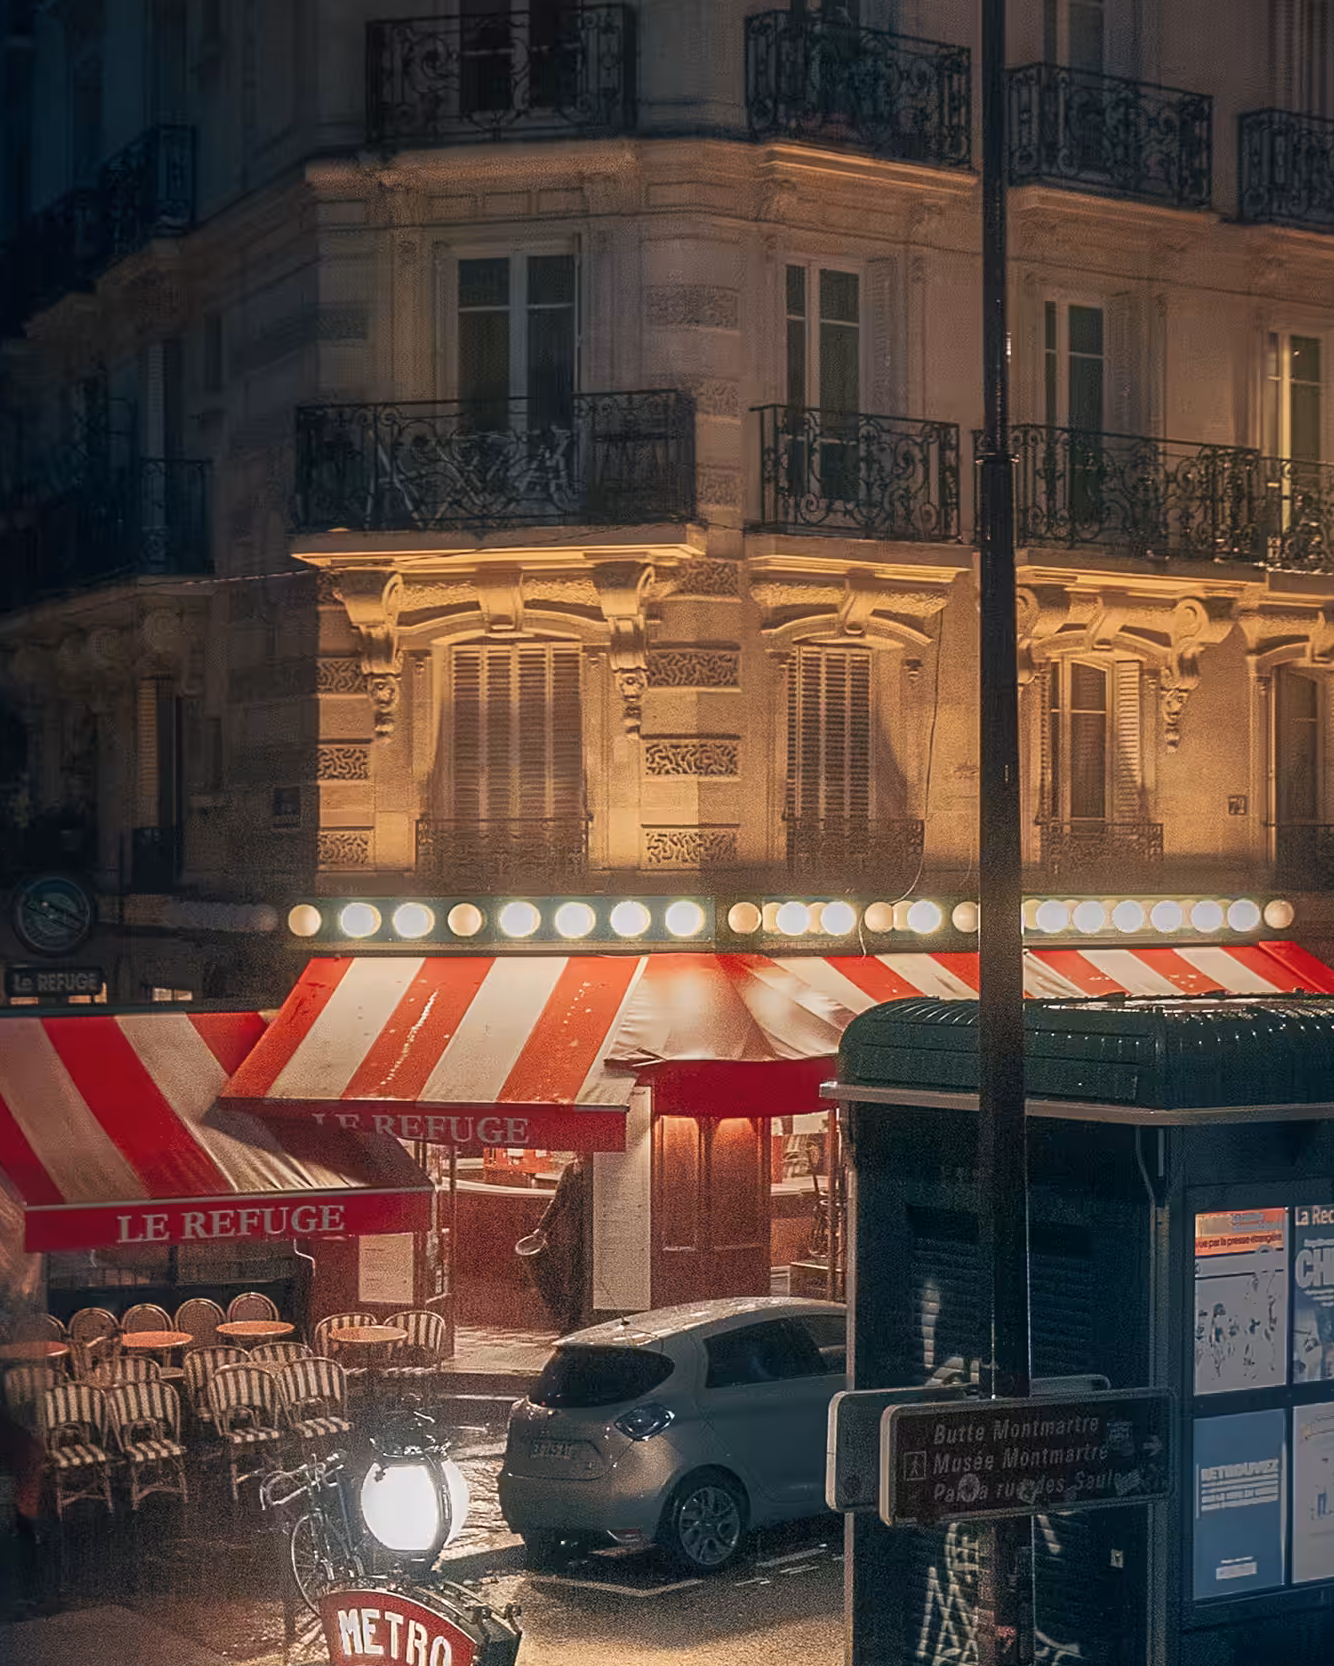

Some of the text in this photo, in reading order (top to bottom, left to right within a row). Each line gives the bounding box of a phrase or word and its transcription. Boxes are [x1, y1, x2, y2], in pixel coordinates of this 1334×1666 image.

[37, 973, 98, 992] REFUGE
[372, 1115, 530, 1144] REFUGE
[117, 1204, 347, 1244] LE REFUGE
[1295, 1206, 1309, 1226] La
[933, 1417, 1100, 1445] Butte Montmartre
[933, 1444, 1108, 1475] Musée Montmartre
